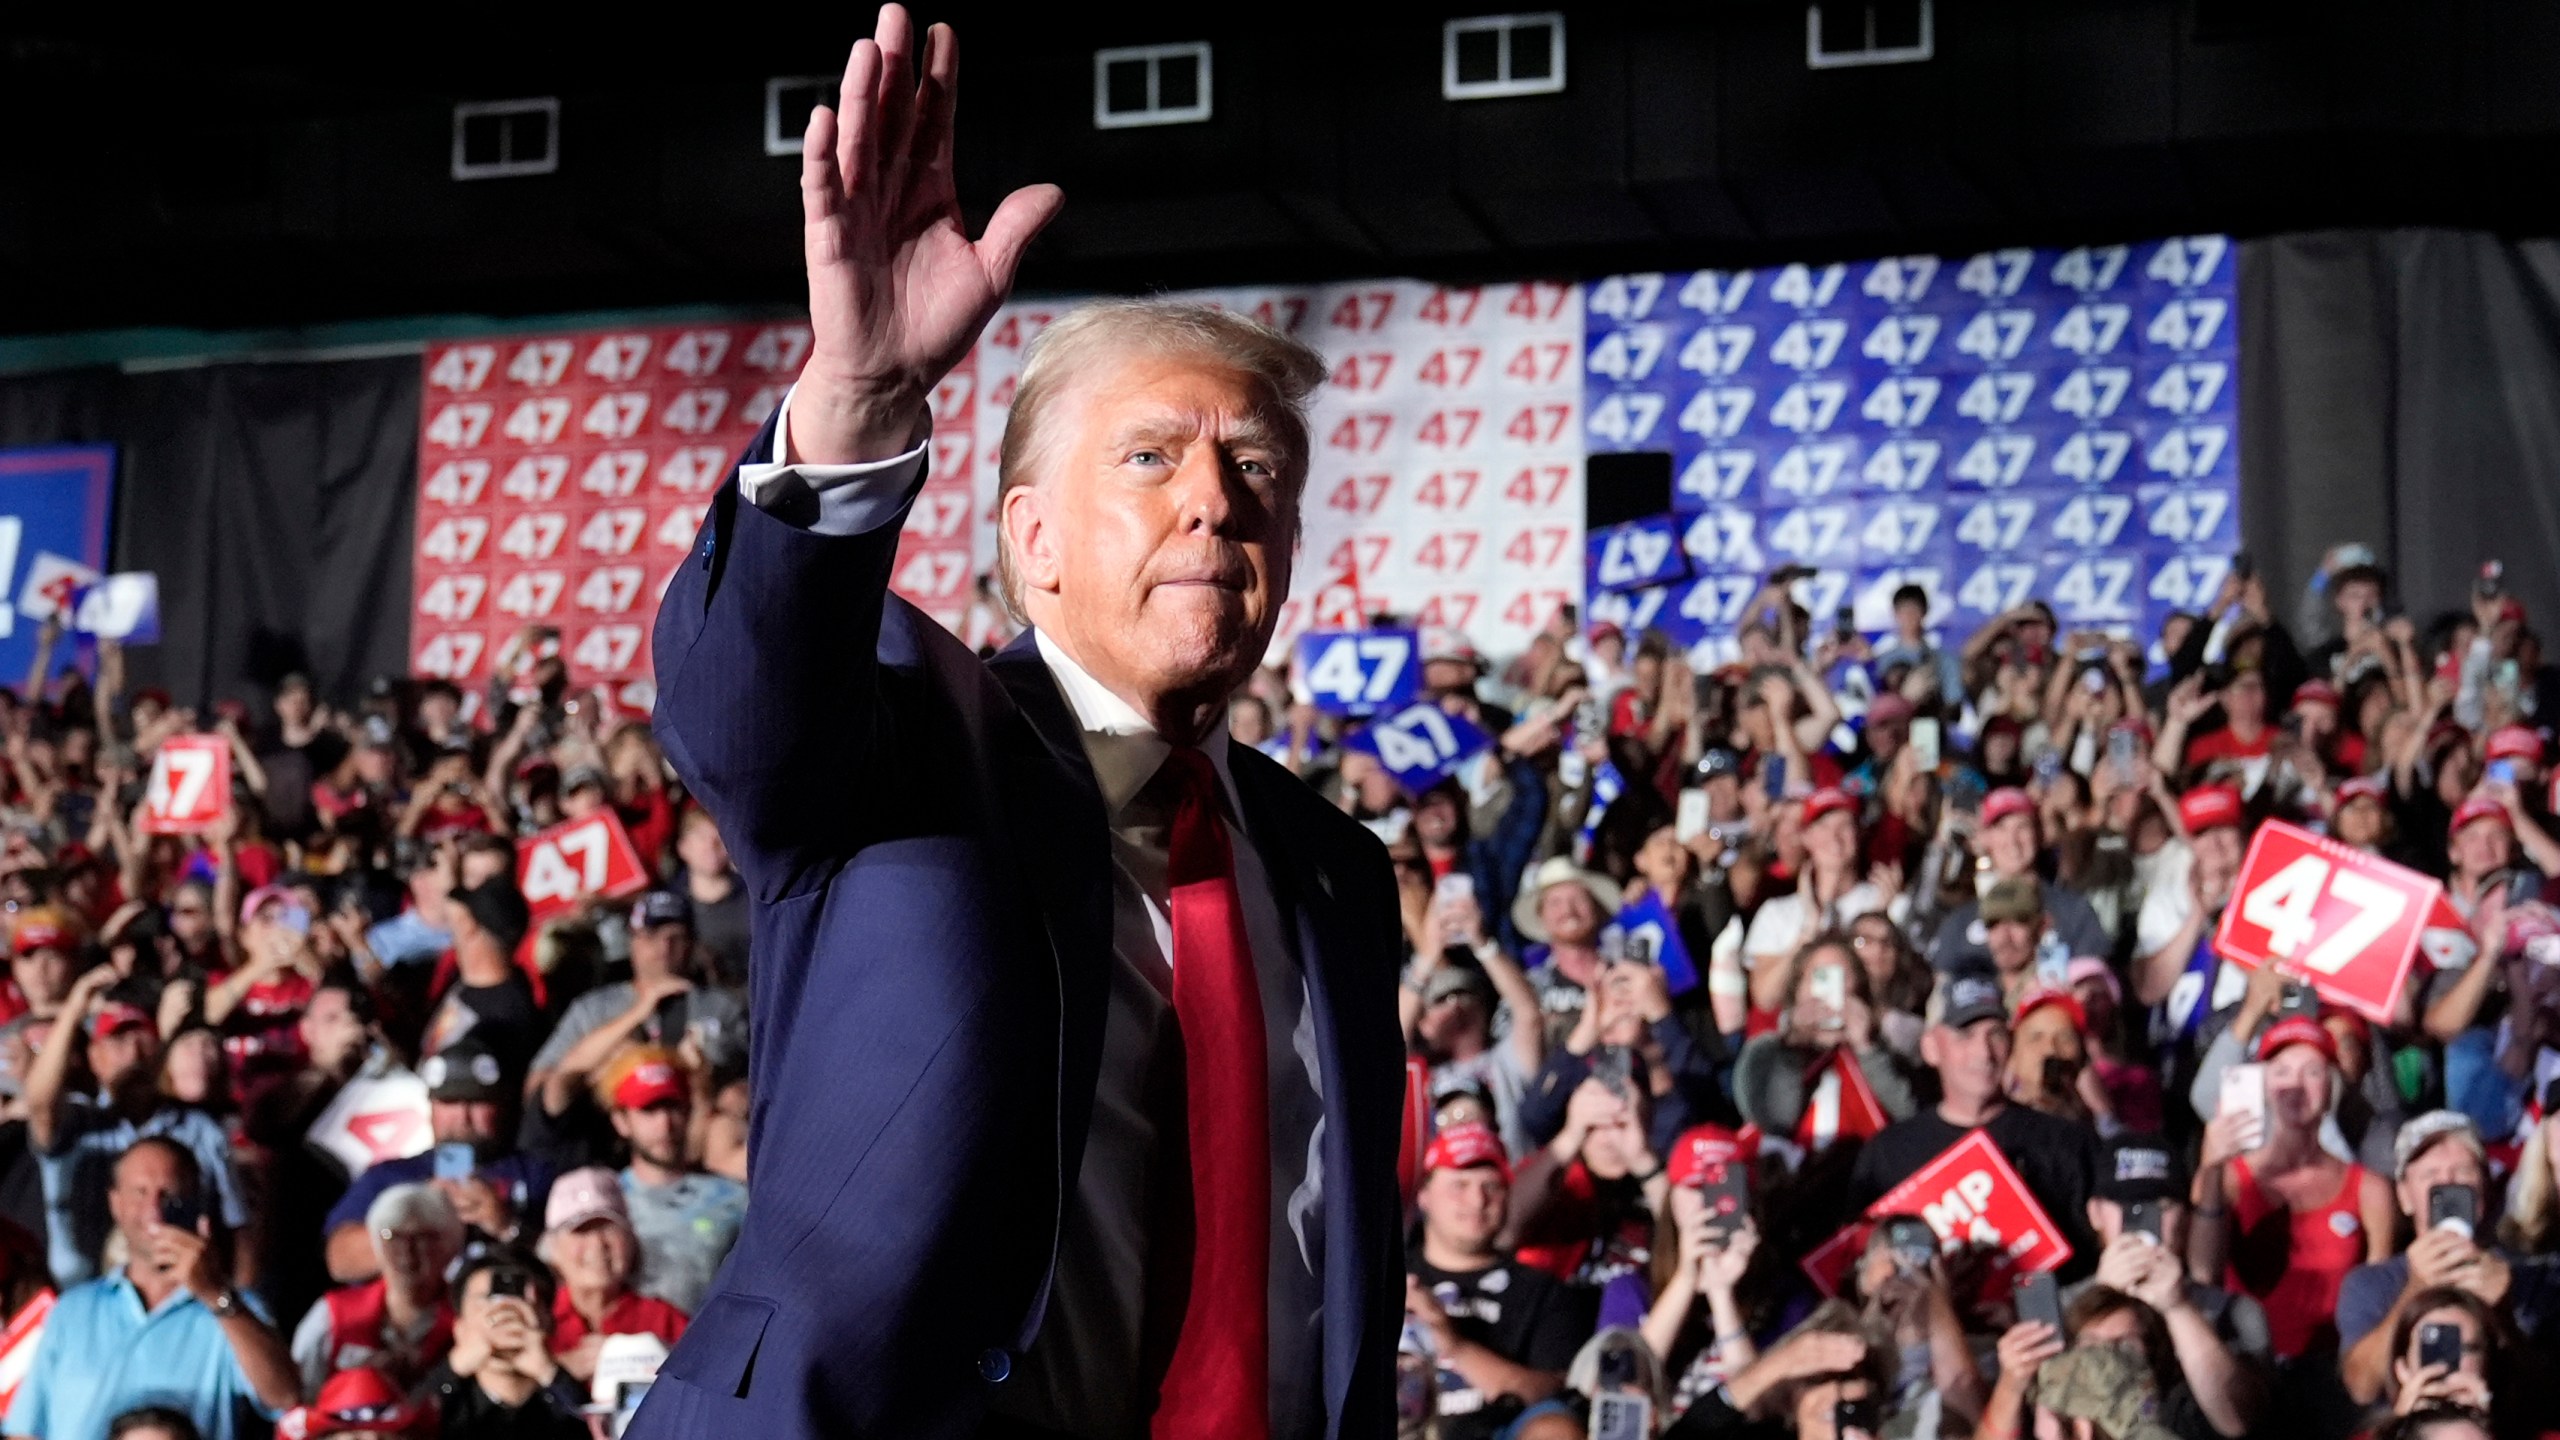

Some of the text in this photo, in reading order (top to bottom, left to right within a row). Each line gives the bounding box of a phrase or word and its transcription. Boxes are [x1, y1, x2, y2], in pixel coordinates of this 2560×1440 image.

[1863, 255, 1939, 303] 47
[1957, 250, 2034, 298] 47
[2052, 246, 2128, 291] 47
[2147, 235, 2227, 286] 47
[1331, 292, 1395, 332] 47
[1418, 289, 1483, 327] 47
[1507, 283, 1571, 320] 47
[1588, 274, 1664, 320] 47
[744, 325, 809, 371] 47
[1770, 319, 1847, 370] 47
[1862, 316, 1940, 365] 47
[1957, 310, 2036, 361] 47
[2051, 304, 2131, 355] 47
[2147, 299, 2228, 350] 47
[430, 345, 496, 391] 47
[507, 341, 573, 386] 47
[586, 335, 651, 381] 47
[664, 330, 730, 376] 47
[1331, 353, 1394, 390] 47
[1419, 348, 1484, 386] 47
[1508, 343, 1573, 380] 47
[1587, 325, 1664, 381] 47
[1679, 325, 1755, 376] 47
[662, 388, 728, 433] 47
[741, 384, 790, 425] 4
[1769, 380, 1848, 432] 47
[1861, 377, 1941, 428] 47
[1957, 373, 2037, 424] 47
[2052, 368, 2131, 418] 47
[2147, 362, 2228, 413] 47
[426, 403, 493, 448] 47
[503, 397, 571, 443] 47
[582, 392, 650, 438] 47
[1330, 414, 1394, 452] 47
[1417, 409, 1483, 447] 47
[1507, 404, 1573, 443] 47
[1586, 393, 1665, 442] 47
[1678, 387, 1755, 438] 47
[581, 449, 648, 497] 47
[659, 446, 727, 494] 47
[1679, 449, 1755, 500] 47
[1769, 442, 1847, 496] 47
[1861, 440, 1941, 491] 47
[1957, 435, 2036, 486] 47
[2052, 431, 2132, 482] 47
[2147, 426, 2229, 478] 47
[424, 459, 491, 506] 47
[502, 455, 569, 501] 47
[1329, 474, 1393, 514] 47
[1416, 470, 1481, 508] 47
[1506, 465, 1571, 503] 47
[498, 512, 567, 559] 47
[579, 508, 646, 555] 47
[1770, 504, 1848, 557] 47
[1861, 503, 1940, 556] 47
[1957, 498, 2036, 550] 47
[2052, 495, 2133, 546] 47
[2148, 489, 2229, 541] 47
[420, 516, 489, 563] 47
[1415, 531, 1480, 571] 47
[1505, 527, 1570, 564] 47
[1598, 527, 1671, 587] 47
[419, 574, 487, 621] 47
[497, 570, 566, 618] 47
[576, 565, 643, 612] 47
[897, 551, 967, 596] 47
[1957, 564, 2037, 616] 47
[2053, 558, 2133, 613] 47
[2148, 554, 2230, 607] 47
[1416, 593, 1480, 628] 47
[1680, 575, 1756, 626] 47
[415, 631, 484, 678] 47
[574, 624, 643, 673] 47
[1307, 636, 1410, 702] 47
[1373, 703, 1460, 774] 47
[522, 820, 610, 903] 47
[2242, 852, 2408, 976] 47
